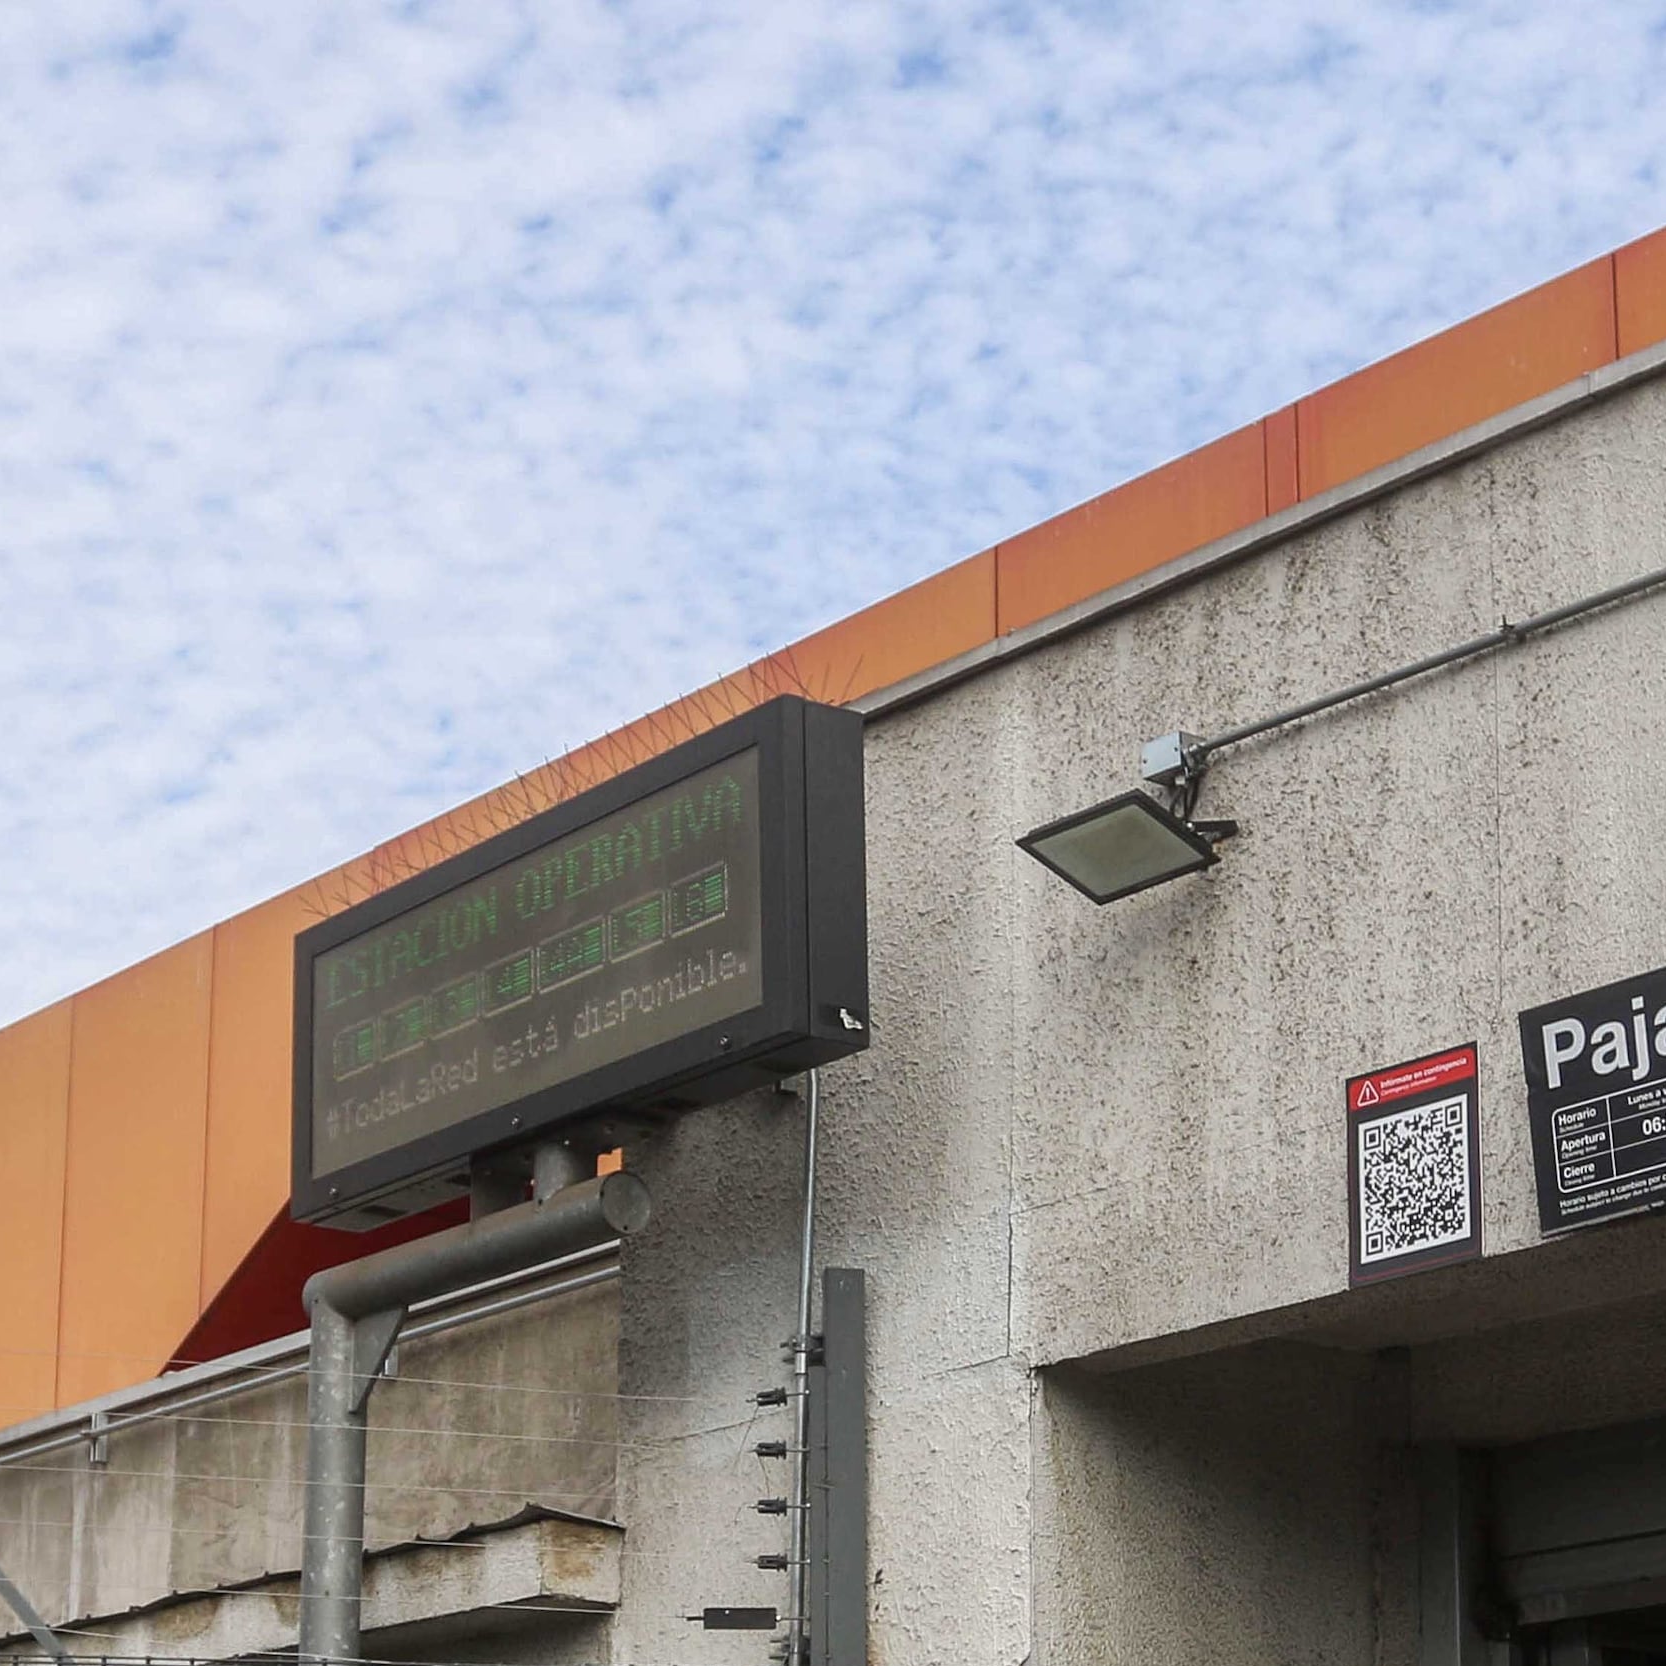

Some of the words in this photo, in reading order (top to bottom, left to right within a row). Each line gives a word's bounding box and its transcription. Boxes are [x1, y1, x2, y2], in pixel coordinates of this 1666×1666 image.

[515, 775, 742, 919] OPERATIVA
[493, 1014, 559, 1073] está
[1627, 1091, 1654, 1106] Lunes
[1557, 1107, 1597, 1126] Horario
[1560, 1131, 1606, 1153] Apertura
[1563, 1163, 1595, 1179] Cierre
